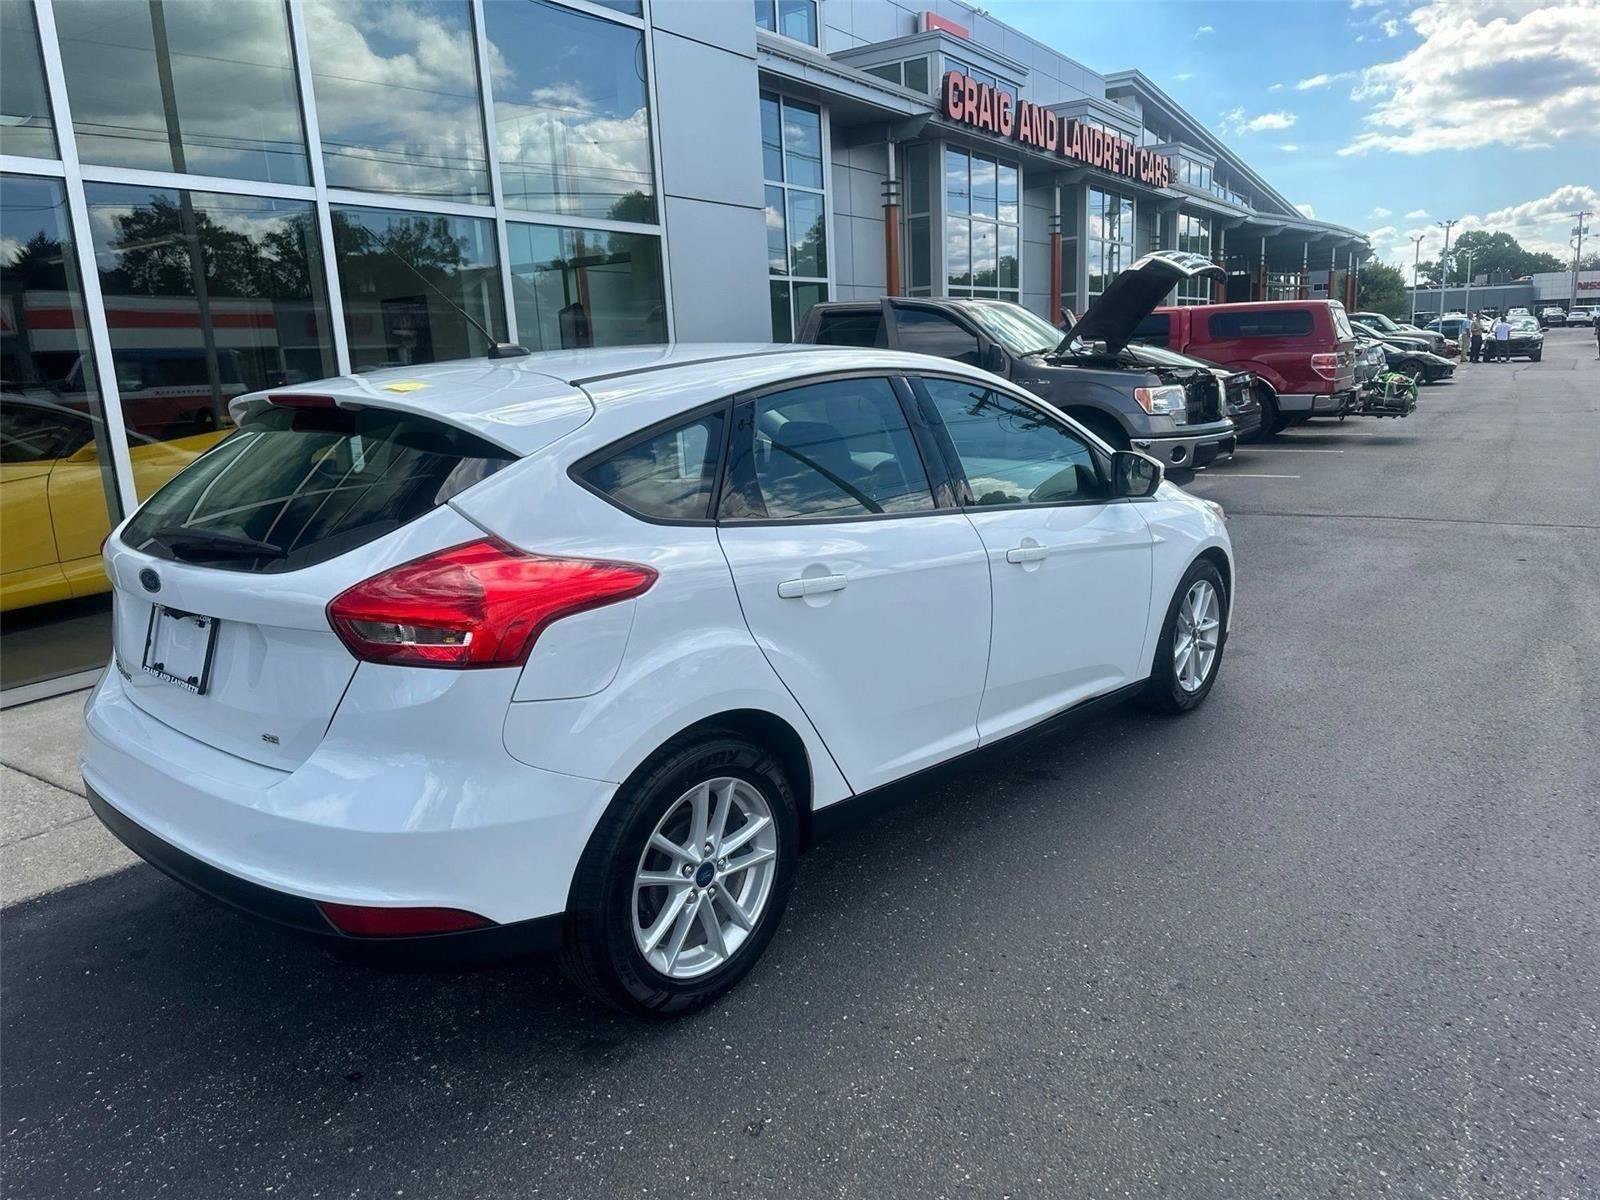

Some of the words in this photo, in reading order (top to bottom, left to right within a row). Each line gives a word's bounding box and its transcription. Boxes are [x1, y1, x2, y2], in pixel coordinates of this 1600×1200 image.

[944, 70, 1015, 137] CRAIG
[1019, 100, 1058, 152] AND
[1063, 117, 1136, 178] LANDRETH
[1140, 148, 1169, 188] CARS
